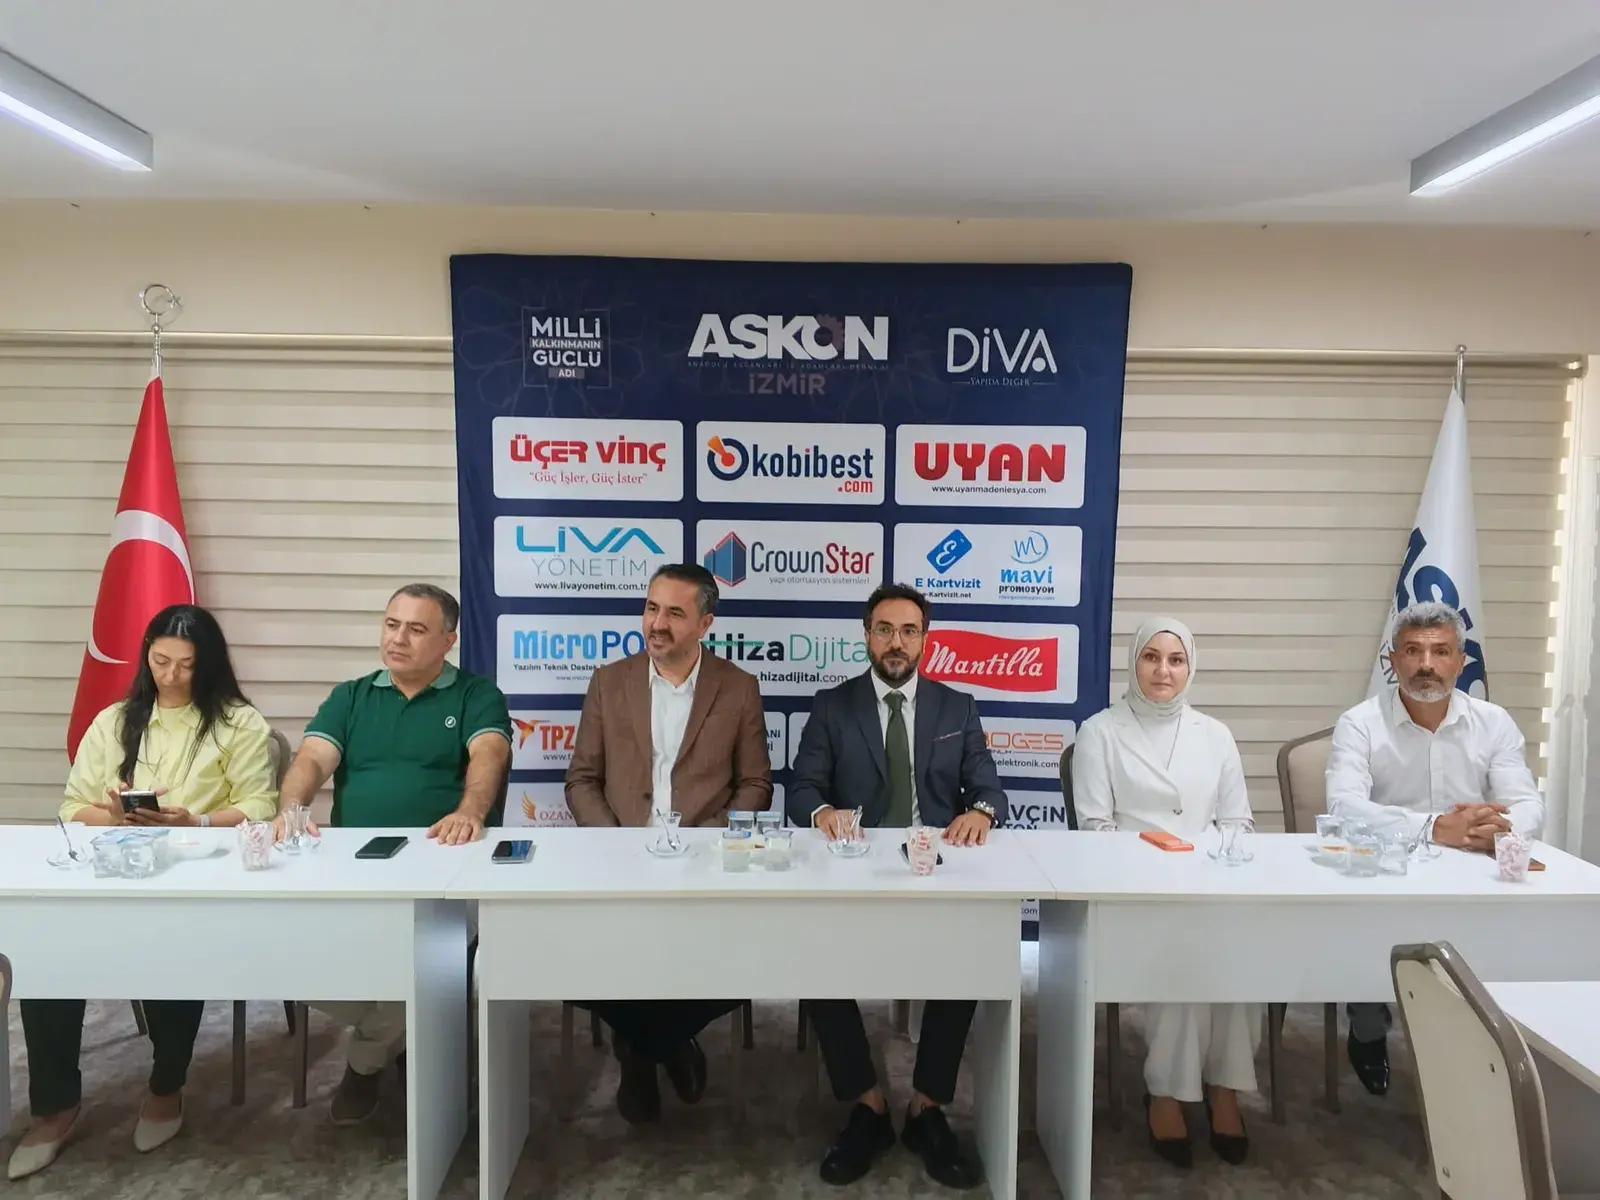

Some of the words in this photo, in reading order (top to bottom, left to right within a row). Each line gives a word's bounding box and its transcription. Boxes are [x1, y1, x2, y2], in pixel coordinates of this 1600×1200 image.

[688, 313, 889, 360] ASKON
[558, 369, 576, 378] ADI
[752, 444, 874, 479] kobibest
[914, 443, 1067, 483] UYAN
[591, 472, 614, 486] Güç
[837, 480, 873, 494] .com
[931, 485, 1047, 495] www.uyanmadeniesya.com
[751, 541, 875, 575] CrownStar
[787, 576, 831, 586] otomasyon
[1000, 566, 1053, 584] mavi
[534, 581, 648, 592] www.livayonetim.com.tr
[915, 578, 923, 588] E
[927, 577, 982, 589] Kartvizit
[998, 584, 1055, 595] promosyon
[513, 630, 646, 660] MicroPO
[704, 633, 869, 670] HizaDijita
[924, 641, 1044, 677] Mantilla
[544, 663, 568, 672] Teknik
[759, 671, 849, 684] hizadijital.com
[996, 758, 1059, 769] elektronik.com
